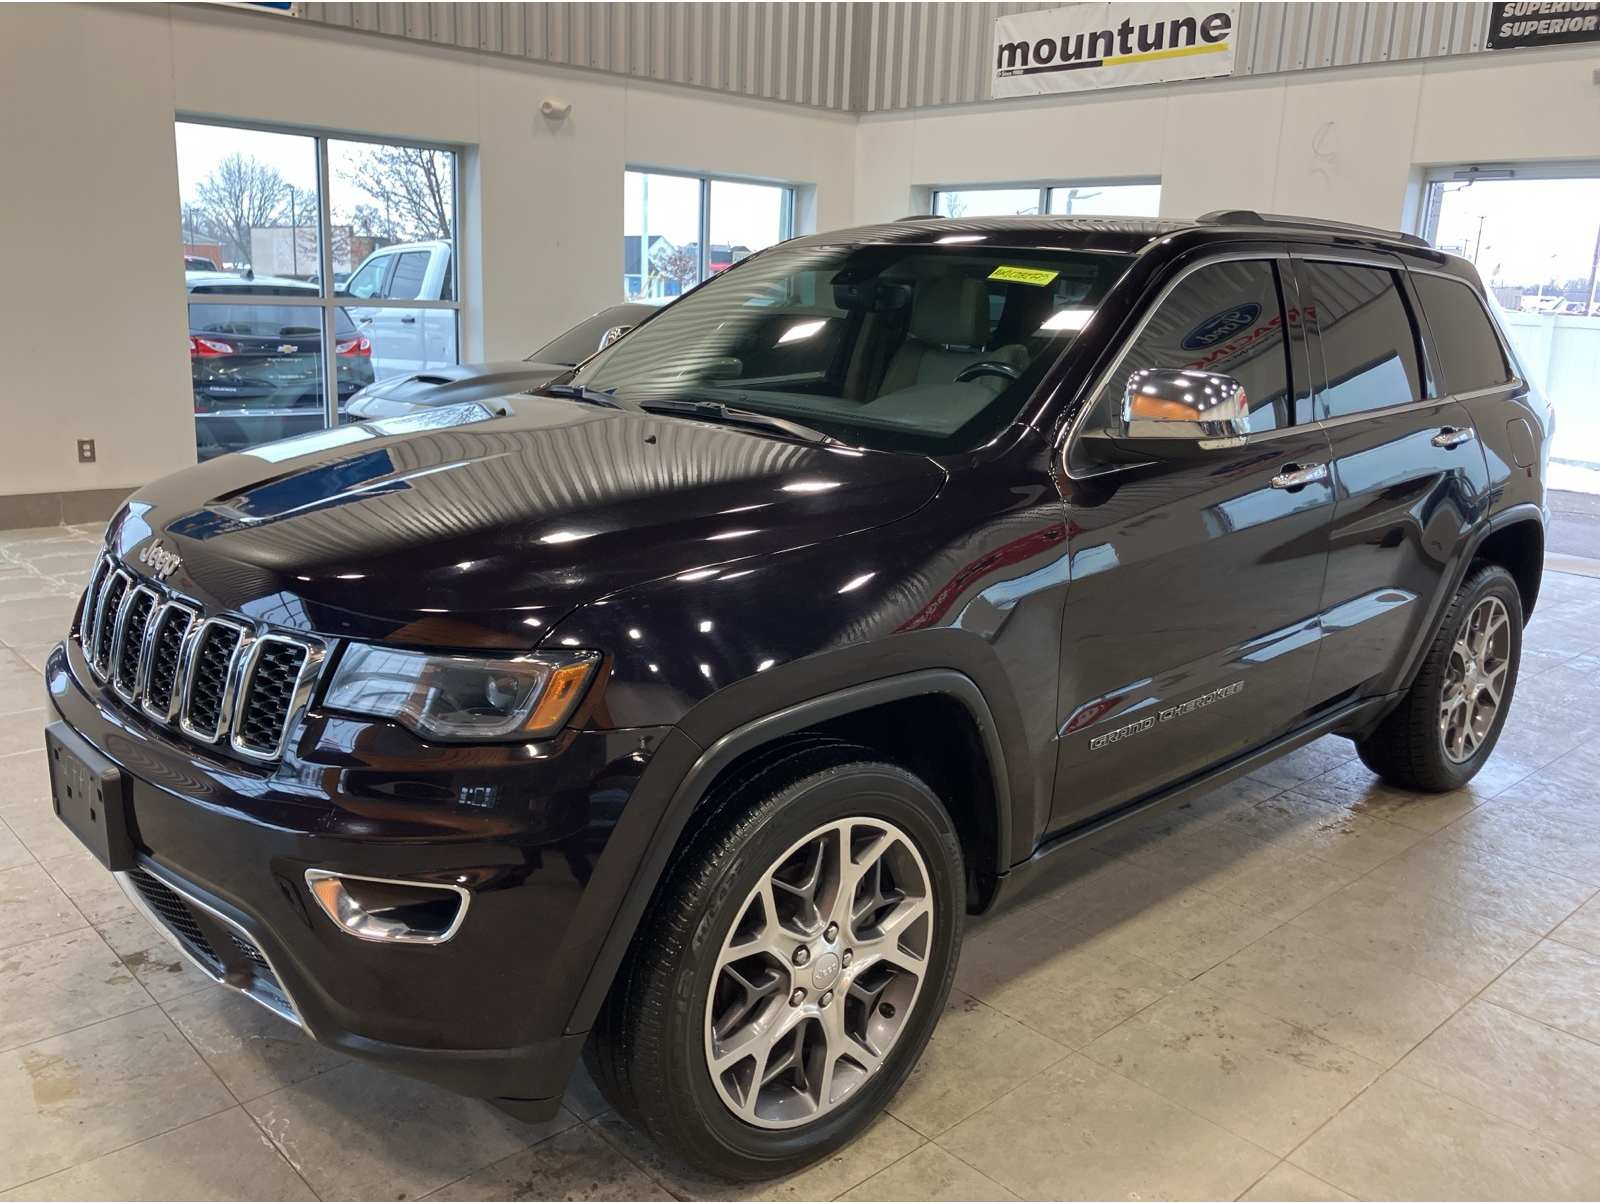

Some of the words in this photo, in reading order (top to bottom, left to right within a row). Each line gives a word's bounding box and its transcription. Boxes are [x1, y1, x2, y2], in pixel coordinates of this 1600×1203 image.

[1499, 15, 1597, 37] SUPERIOR
[1503, 2, 1597, 17] SUPERIOR
[997, 12, 1232, 69] mountune
[140, 538, 181, 580] Jeep
[1090, 716, 1156, 750] GRAND
[1159, 680, 1245, 722] CHEROKEE
